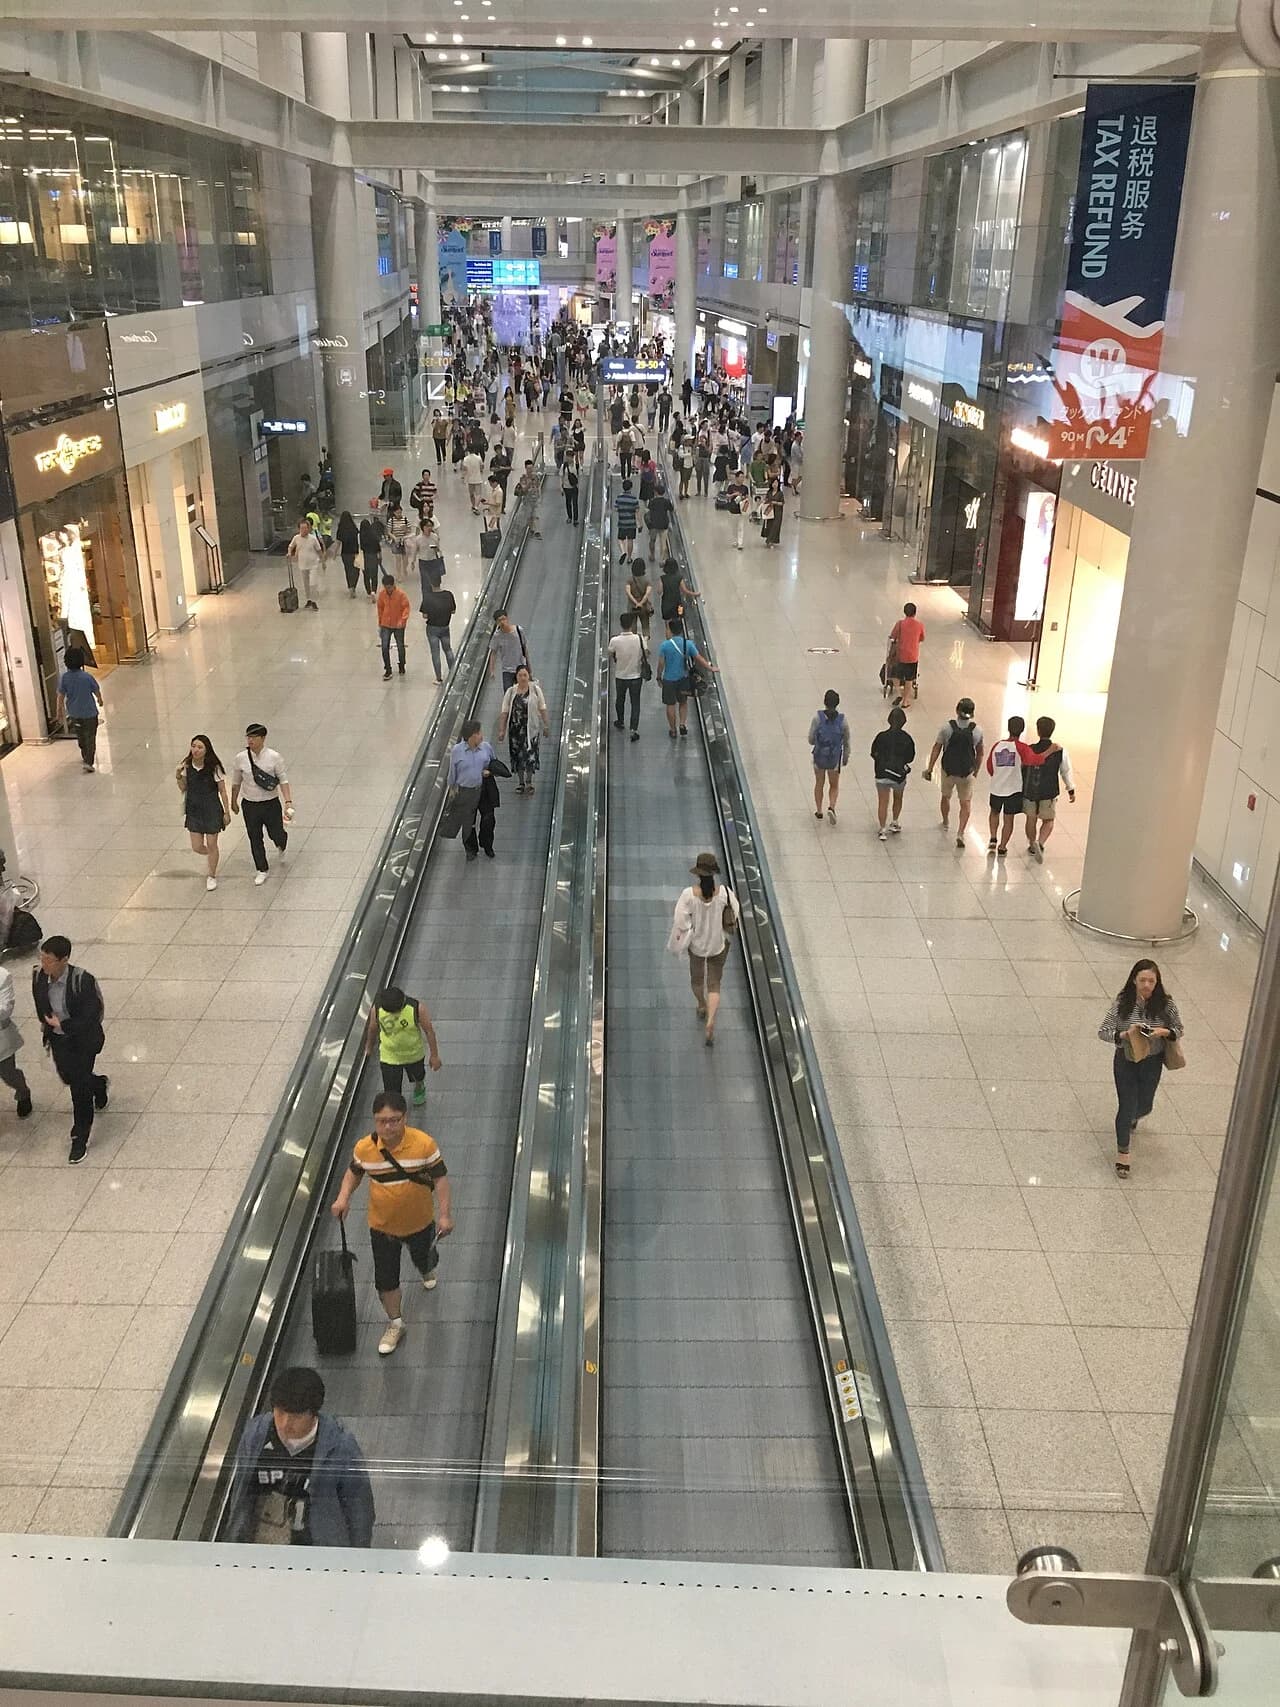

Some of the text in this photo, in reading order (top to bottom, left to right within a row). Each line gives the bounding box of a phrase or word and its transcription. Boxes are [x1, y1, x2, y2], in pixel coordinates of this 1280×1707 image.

[1081, 115, 1125, 279] TAX REFUND
[1119, 115, 1158, 240] 退税服务
[1090, 460, 1138, 508] CÉLINE
